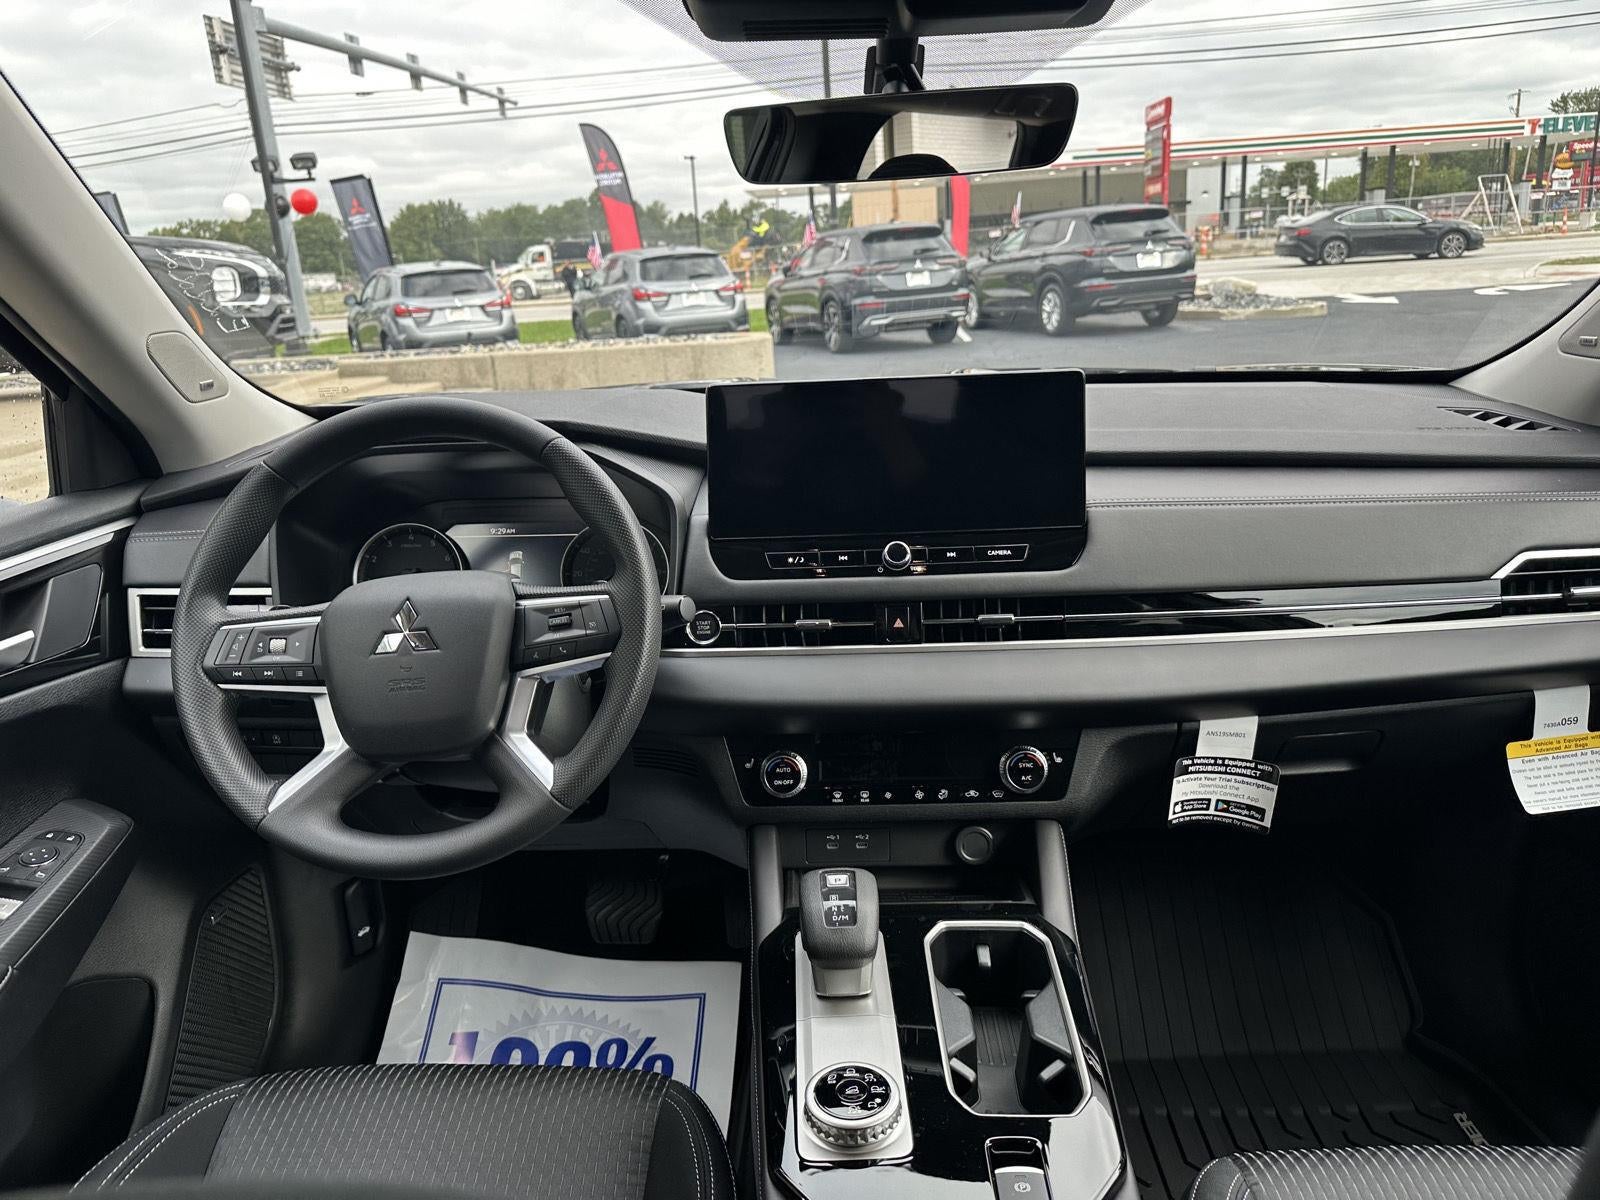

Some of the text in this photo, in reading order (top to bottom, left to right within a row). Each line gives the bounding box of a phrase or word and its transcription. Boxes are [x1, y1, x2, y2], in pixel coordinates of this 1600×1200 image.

[1527, 115, 1597, 134] 7-ELEVE
[1563, 735, 1589, 744] Equipped
[1535, 745, 1562, 753] Advanced
[1551, 752, 1578, 760] Advanced
[1590, 749, 1600, 757] Bag
[1224, 760, 1256, 768] Equipped
[1257, 764, 1273, 772] with
[1226, 766, 1262, 777] CONNECT
[1233, 778, 1275, 792] Subscription
[1219, 791, 1245, 799] Connect
[1228, 805, 1250, 815] Google
[1250, 810, 1262, 819] Play
